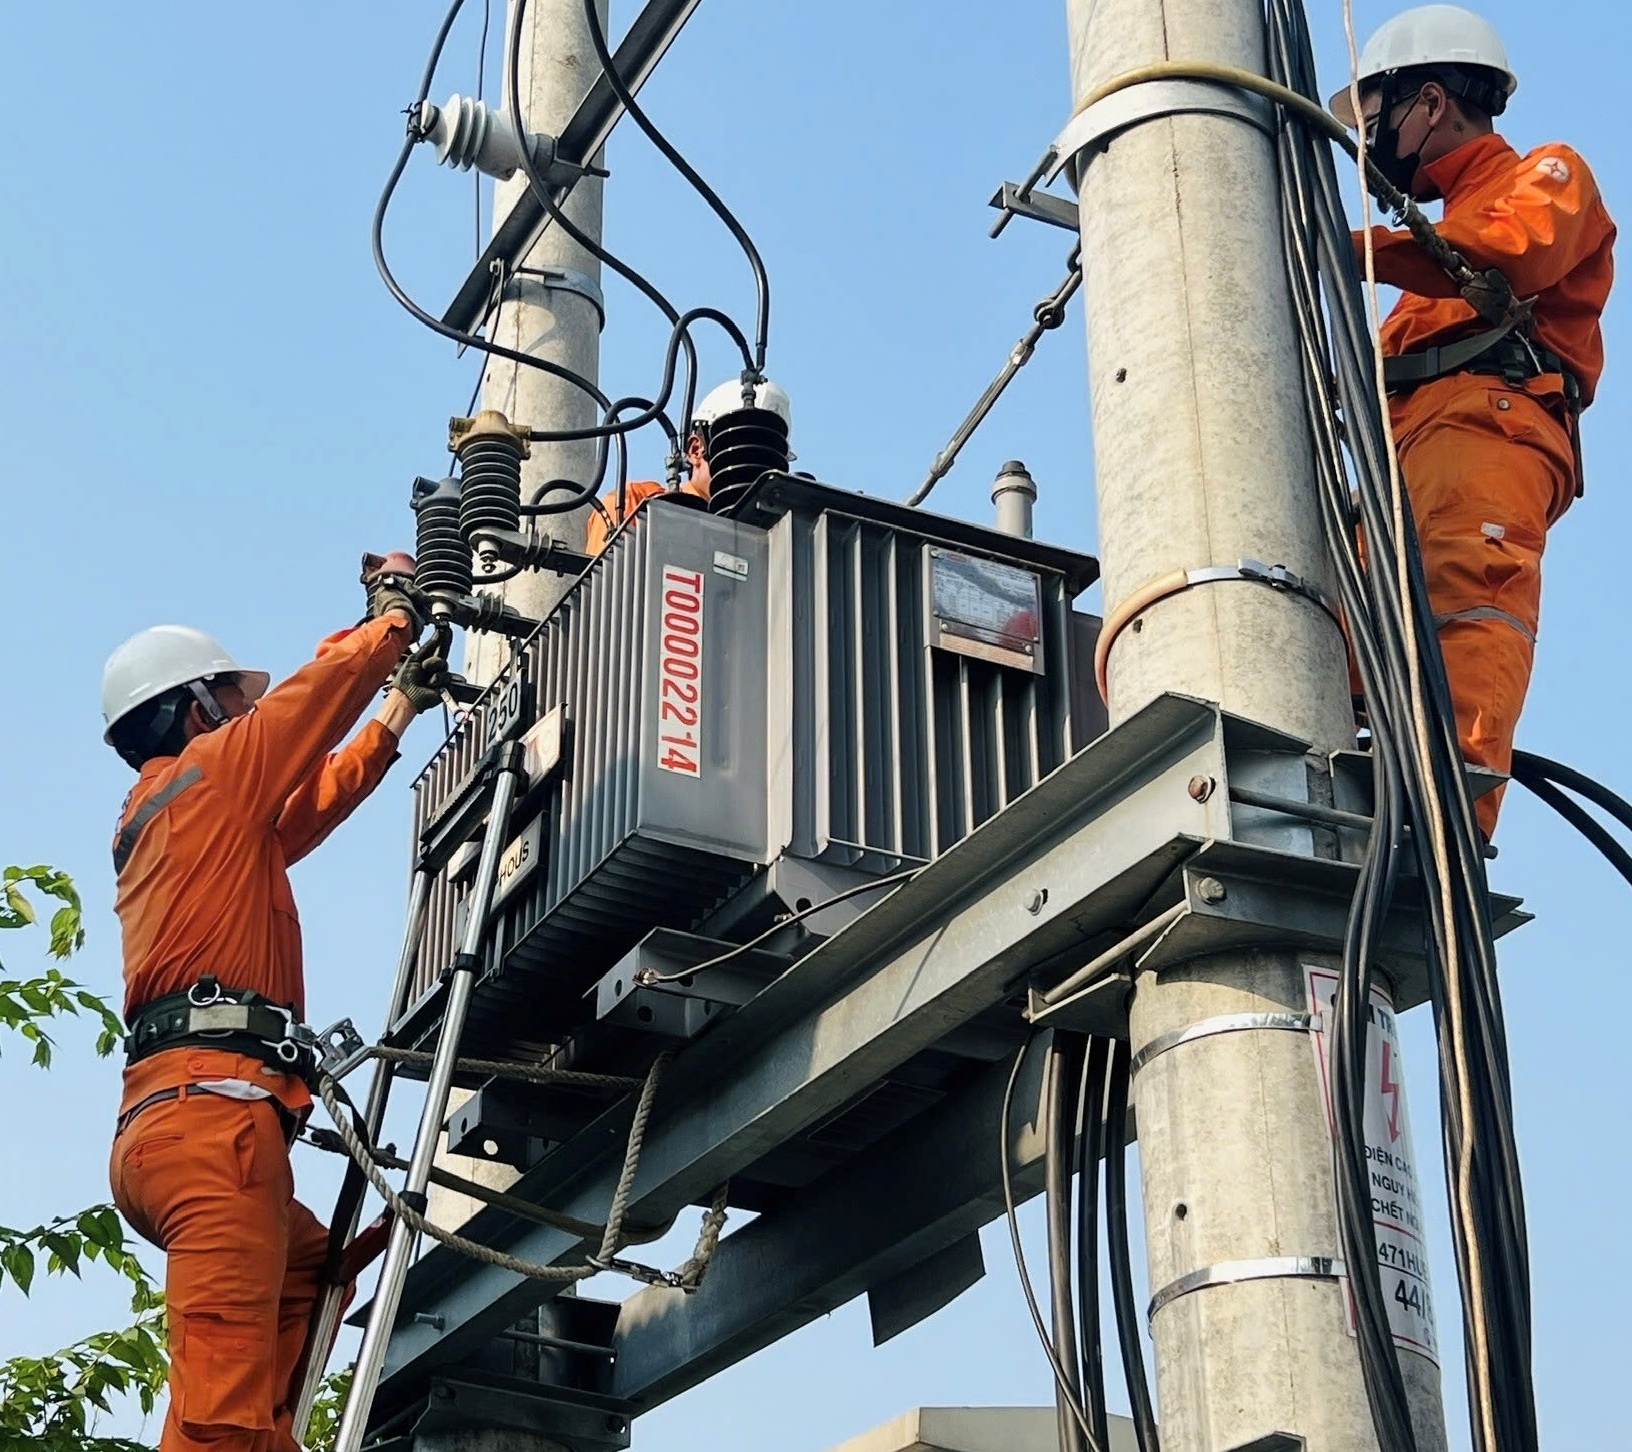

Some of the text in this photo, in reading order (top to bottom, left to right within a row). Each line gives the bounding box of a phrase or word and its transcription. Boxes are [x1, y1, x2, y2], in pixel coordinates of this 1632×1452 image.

[660, 572, 701, 774] T00002214
[488, 682, 519, 745] 250
[1371, 1172, 1405, 1196] NGUY
[1371, 1197, 1404, 1221] CHẾT
